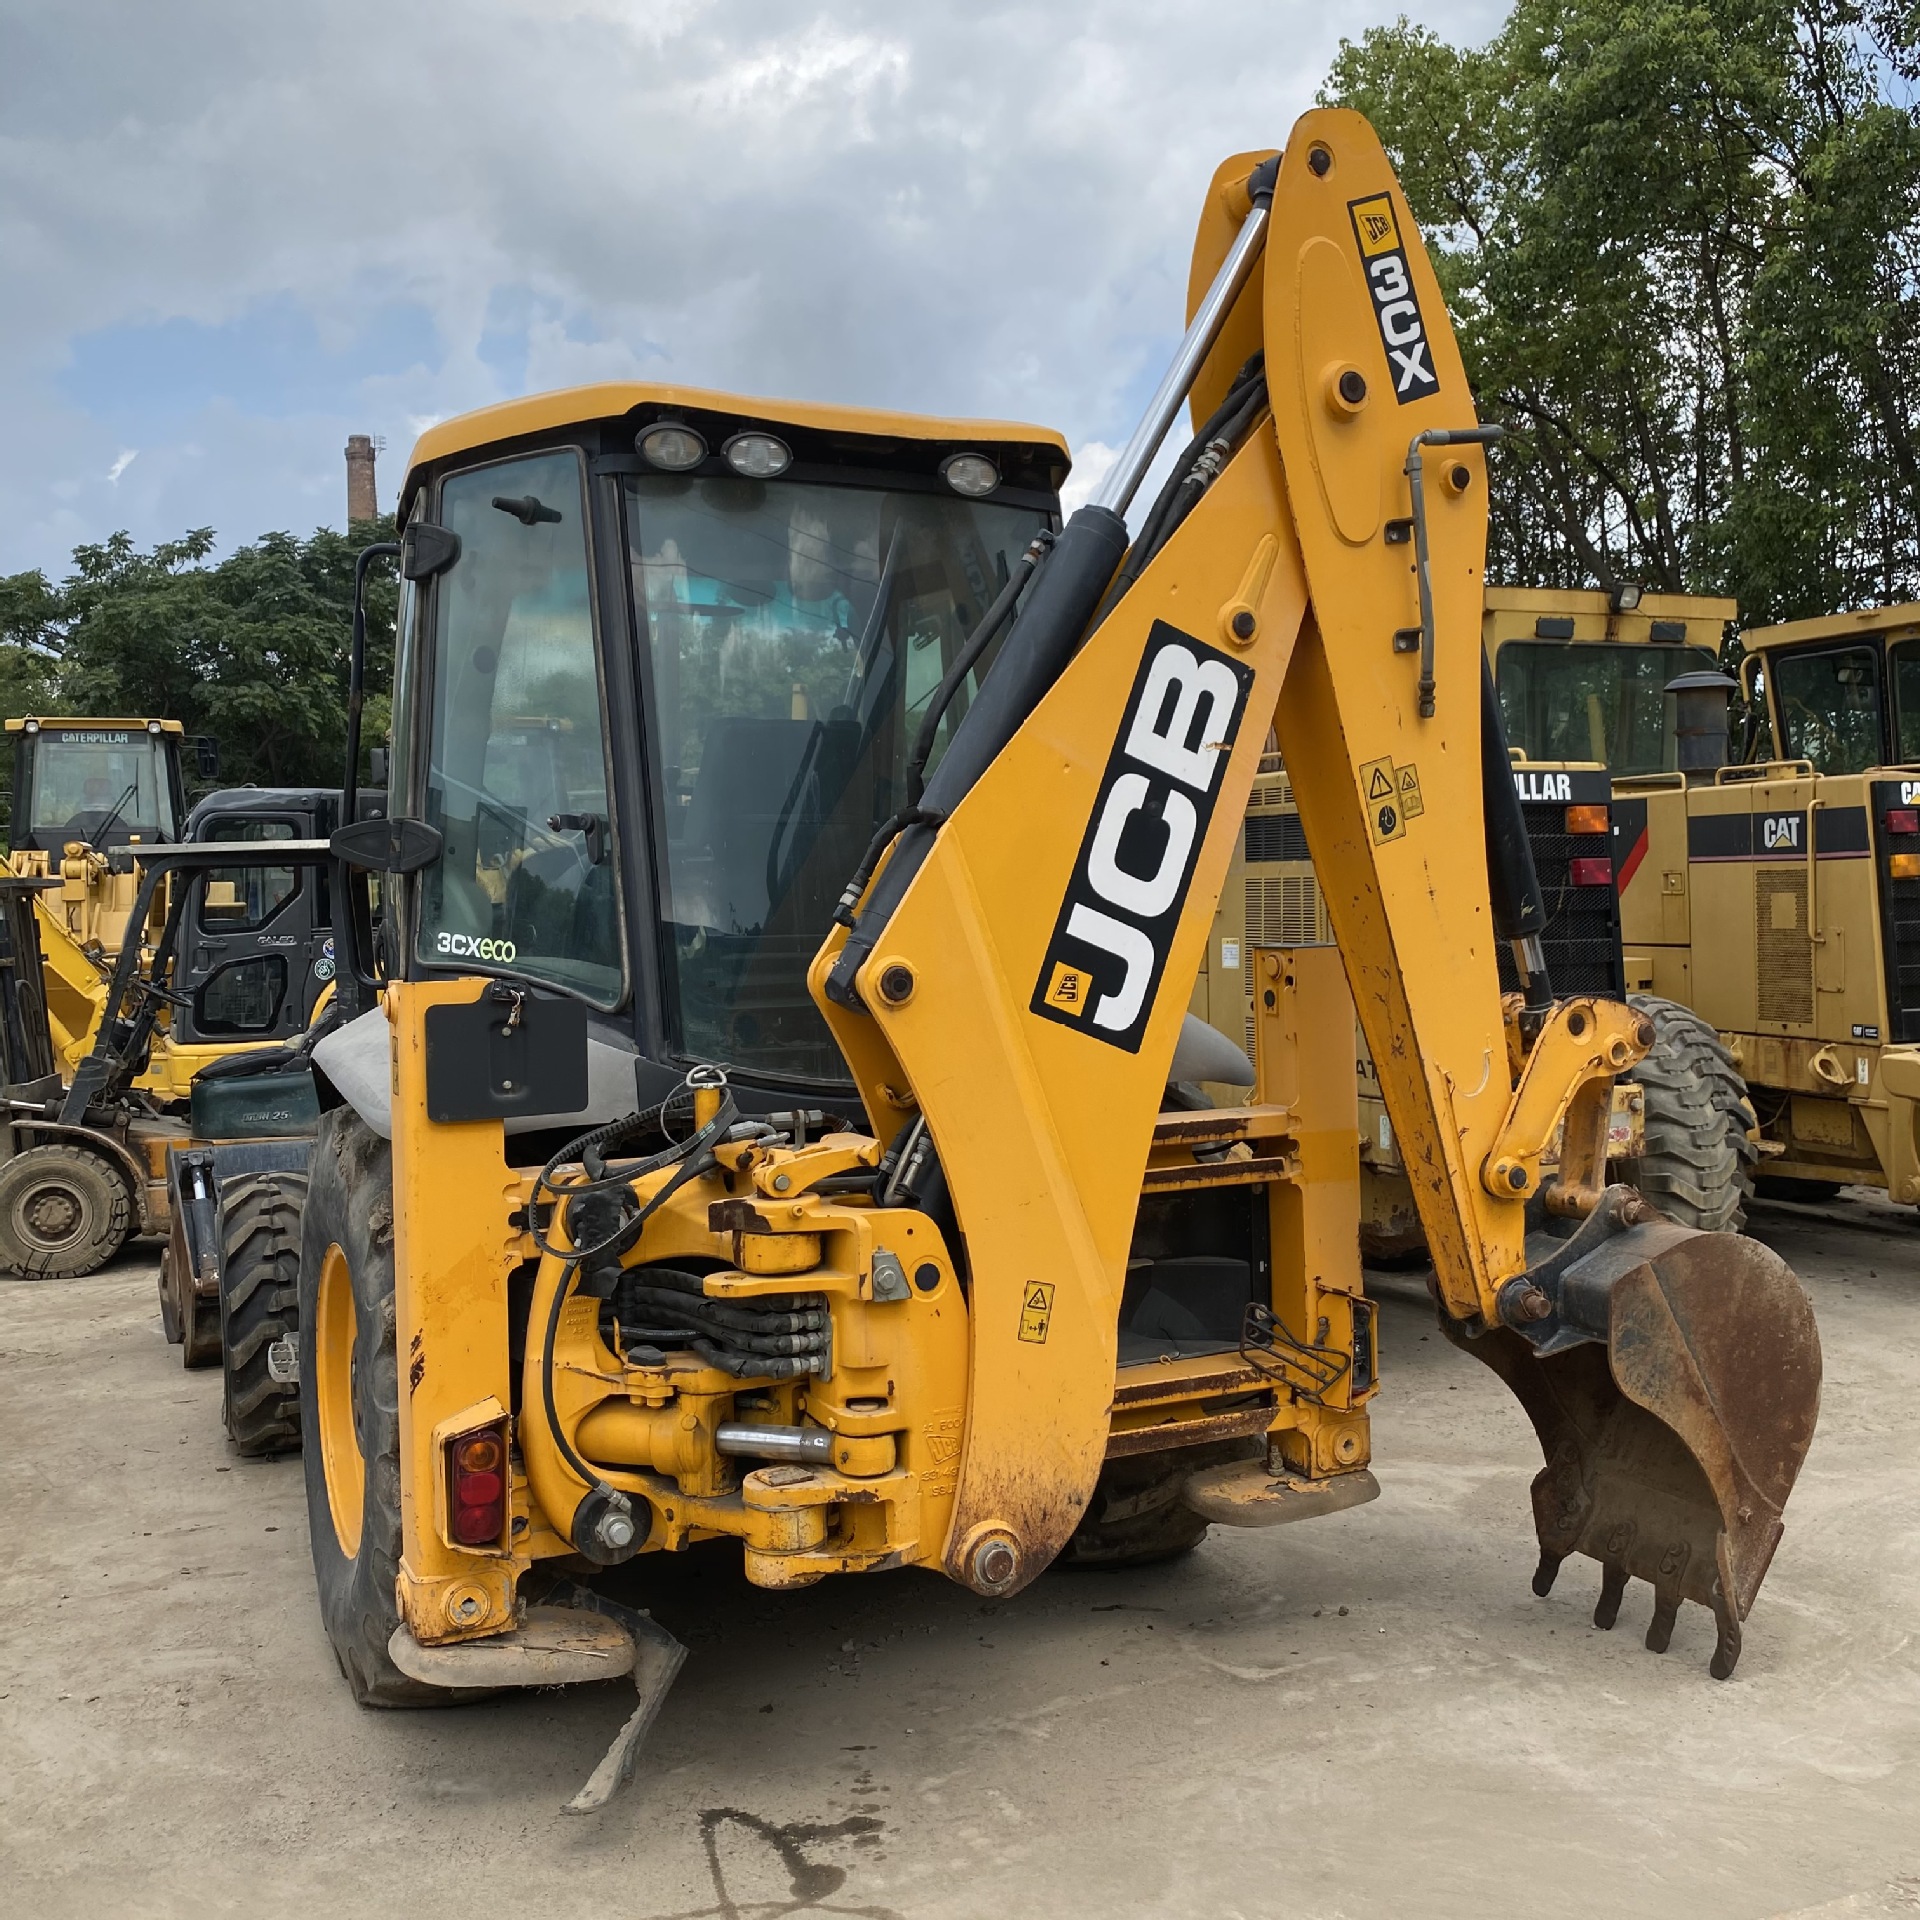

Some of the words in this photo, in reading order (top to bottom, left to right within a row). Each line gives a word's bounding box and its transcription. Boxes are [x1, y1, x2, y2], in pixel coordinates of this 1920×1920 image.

[1365, 216, 1388, 240] JCB
[1370, 255, 1435, 393] 3CX
[61, 732, 129, 744] CATERPILLAR
[1064, 643, 1239, 1032] JCB
[1763, 816, 1800, 848] CAT
[437, 932, 516, 963] 3CXeco
[1057, 975, 1077, 1000] JCB
[272, 1110, 290, 1121] 25
